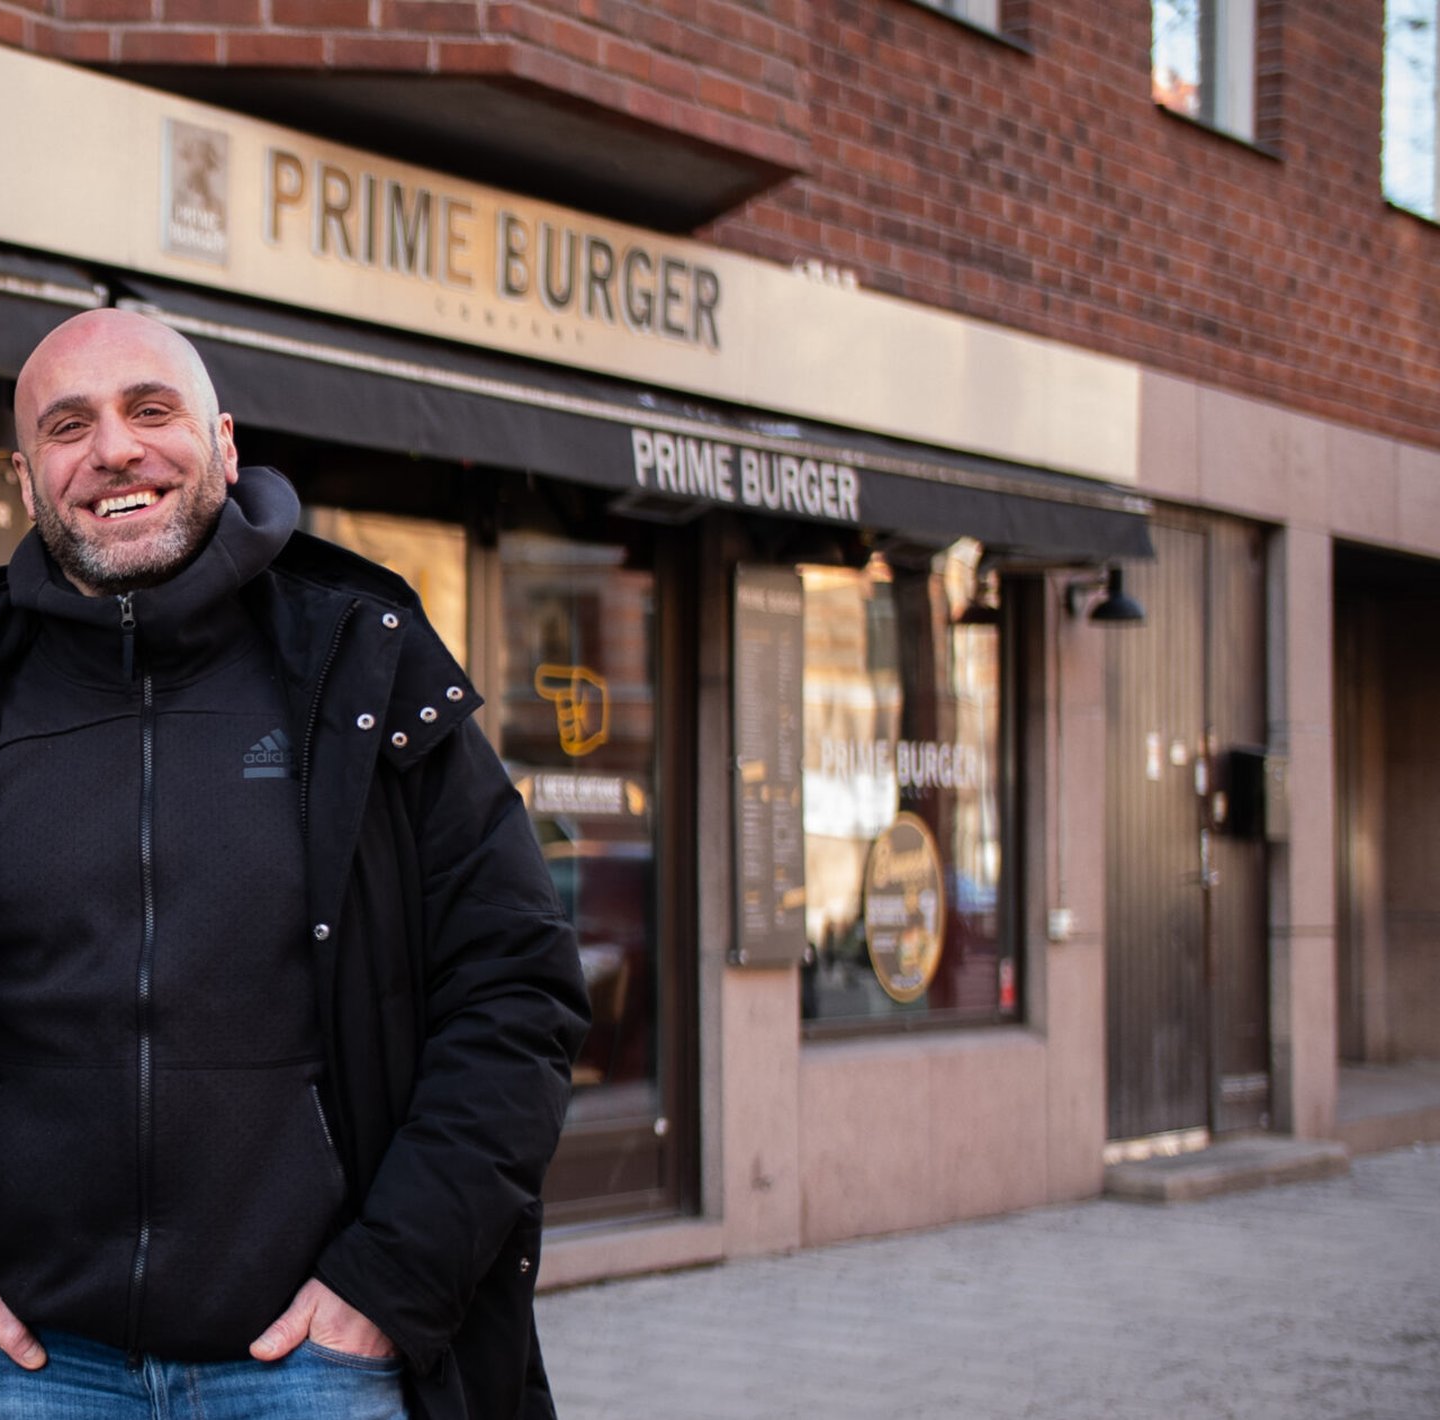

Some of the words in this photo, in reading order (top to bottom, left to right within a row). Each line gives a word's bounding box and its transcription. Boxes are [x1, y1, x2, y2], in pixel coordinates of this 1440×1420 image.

[262, 146, 477, 290] PRIME
[497, 209, 722, 352] BURGER
[632, 428, 735, 502] PRIME
[740, 448, 859, 523] BURGER
[243, 750, 284, 764] adid
[820, 738, 891, 785] PRIME
[897, 739, 979, 789] BURGER
